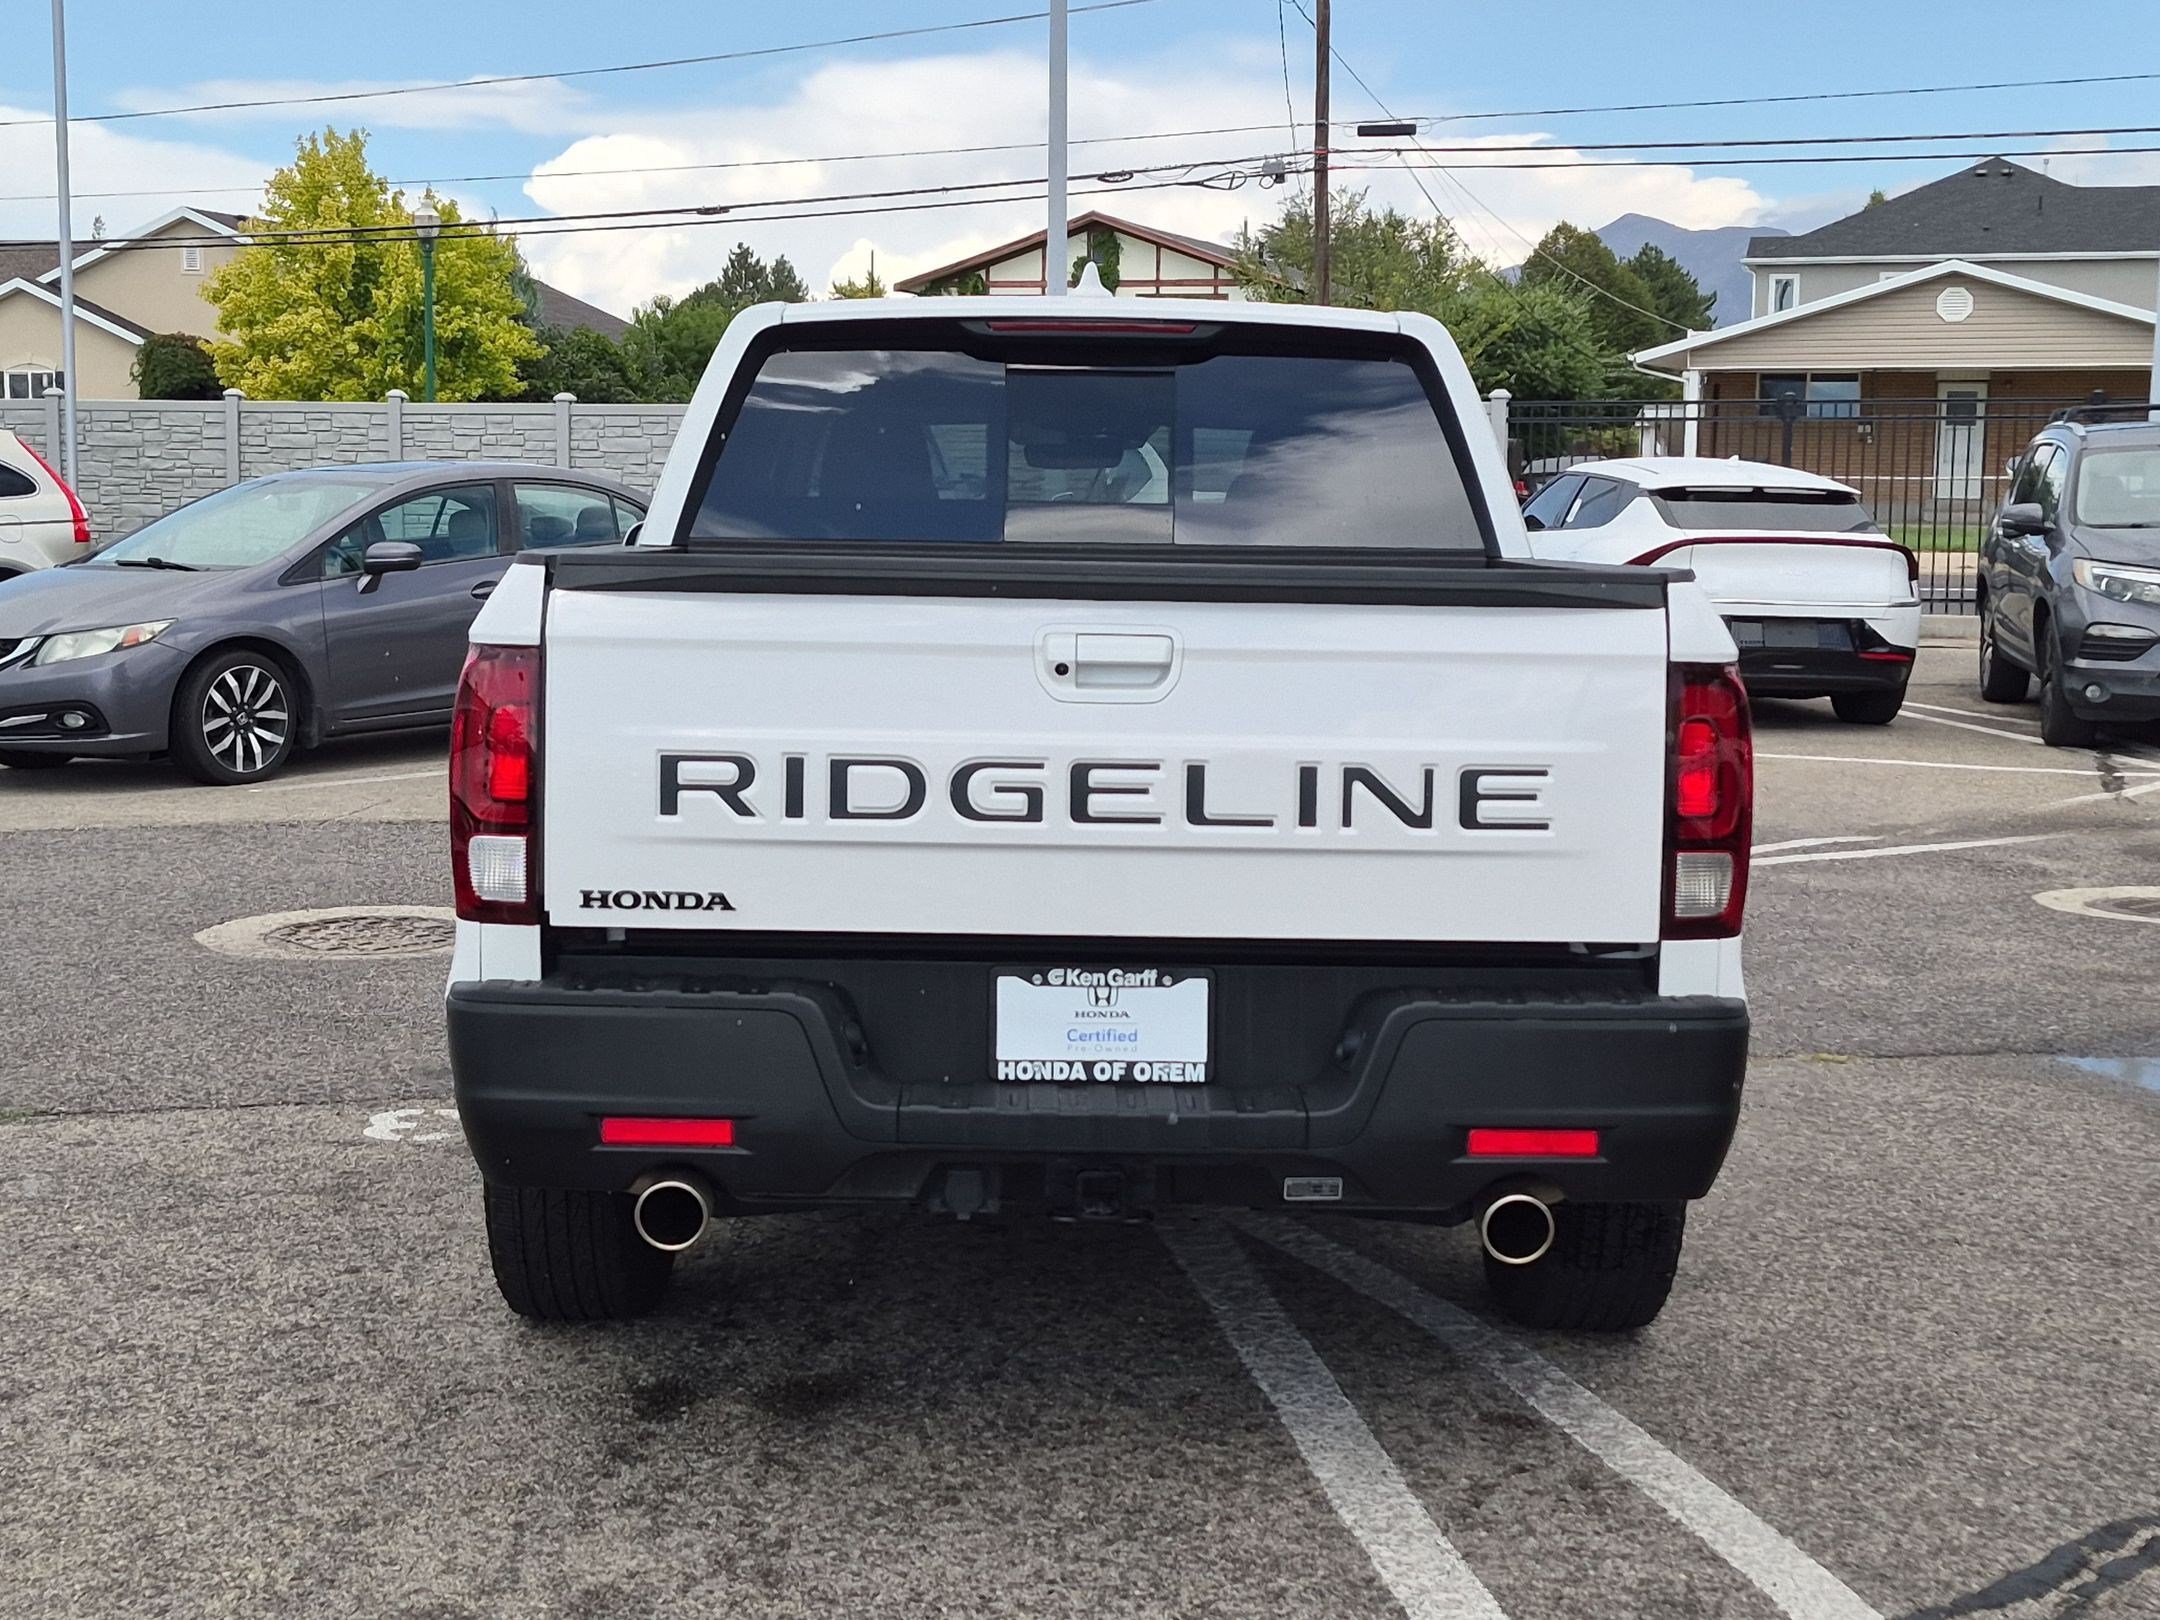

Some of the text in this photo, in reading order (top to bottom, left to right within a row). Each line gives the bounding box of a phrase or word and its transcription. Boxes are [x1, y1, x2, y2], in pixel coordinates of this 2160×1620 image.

[660, 754, 1549, 830] RIDGELINE
[580, 890, 735, 911] HONDA
[1074, 1010, 1130, 1018] HONDA
[1066, 1028, 1138, 1042] Certified
[998, 1061, 1205, 1082] HONDA OF OREM
